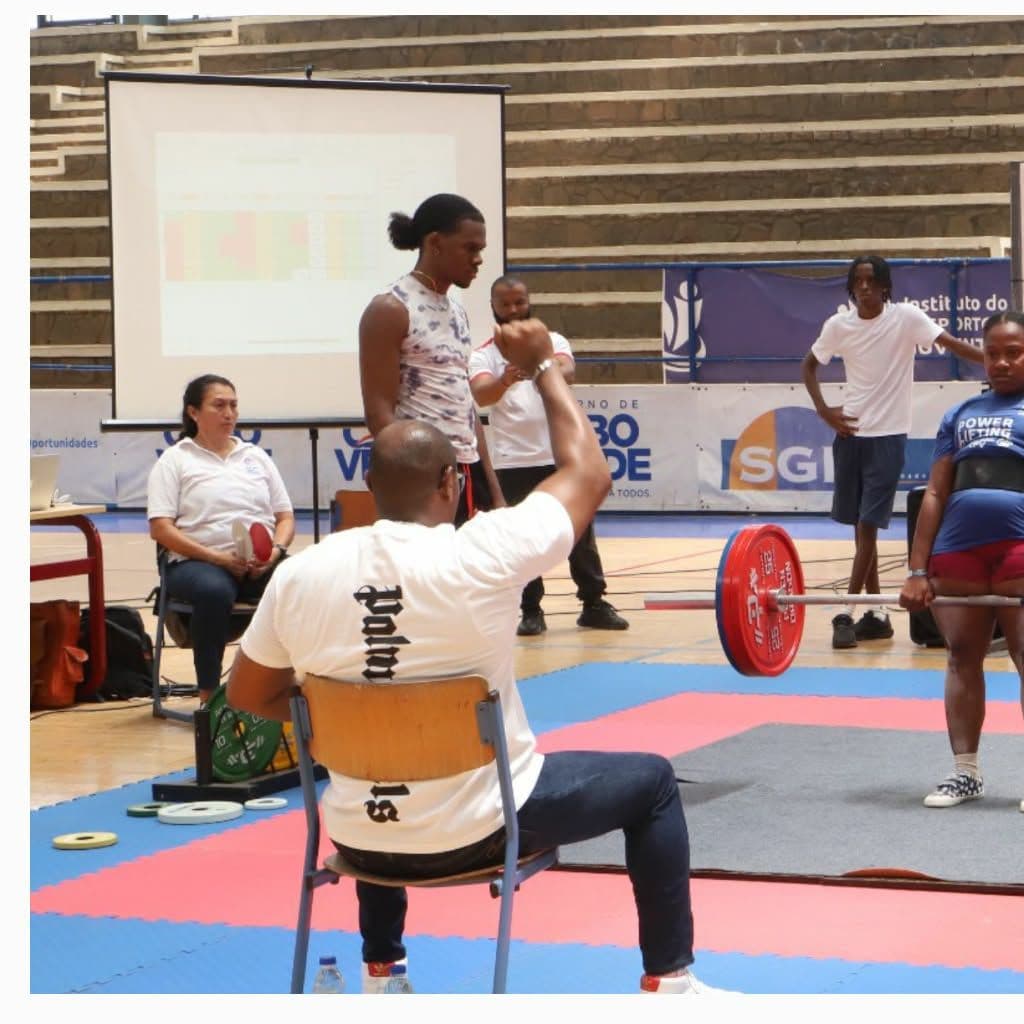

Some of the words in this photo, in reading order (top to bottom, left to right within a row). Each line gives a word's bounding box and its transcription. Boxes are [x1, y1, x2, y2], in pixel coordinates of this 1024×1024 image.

[985, 293, 1008, 311] do
[620, 399, 639, 409] DE
[587, 413, 640, 448] BO
[957, 416, 1015, 433] POWER
[30, 436, 98, 449] portunidades
[618, 489, 650, 498] TODOS
